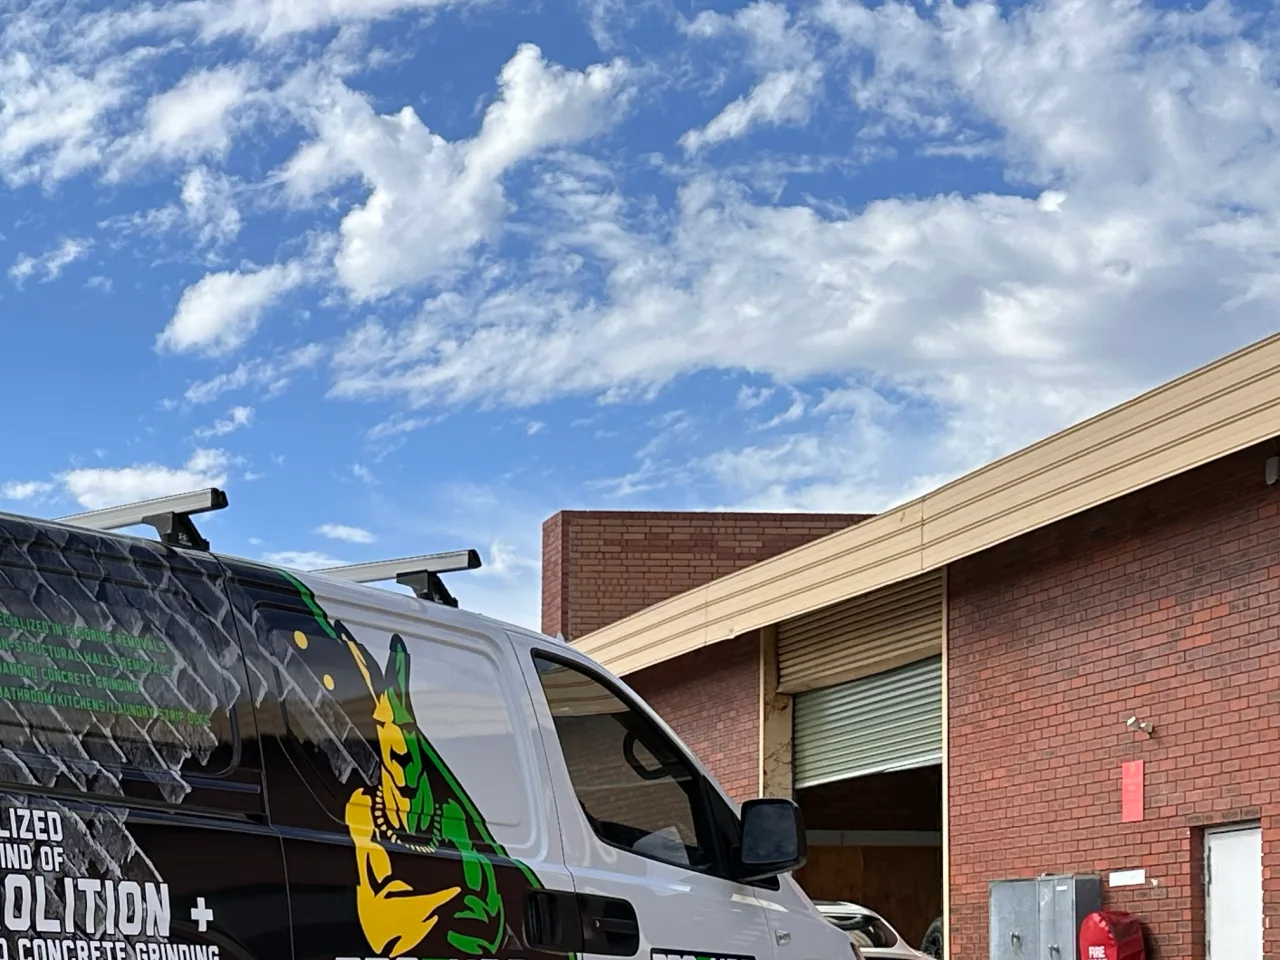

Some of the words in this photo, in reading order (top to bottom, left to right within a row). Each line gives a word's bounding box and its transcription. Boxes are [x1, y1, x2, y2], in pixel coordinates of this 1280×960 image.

[51, 624, 63, 636] IN
[66, 627, 112, 645] FLOORING
[116, 633, 166, 653] REMOVALS
[83, 651, 118, 669] WALLS
[41, 668, 93, 687] CONCRETE
[96, 676, 140, 694] GRINDING
[40, 846, 64, 872] OF
[1088, 945, 1105, 958] FIRE
